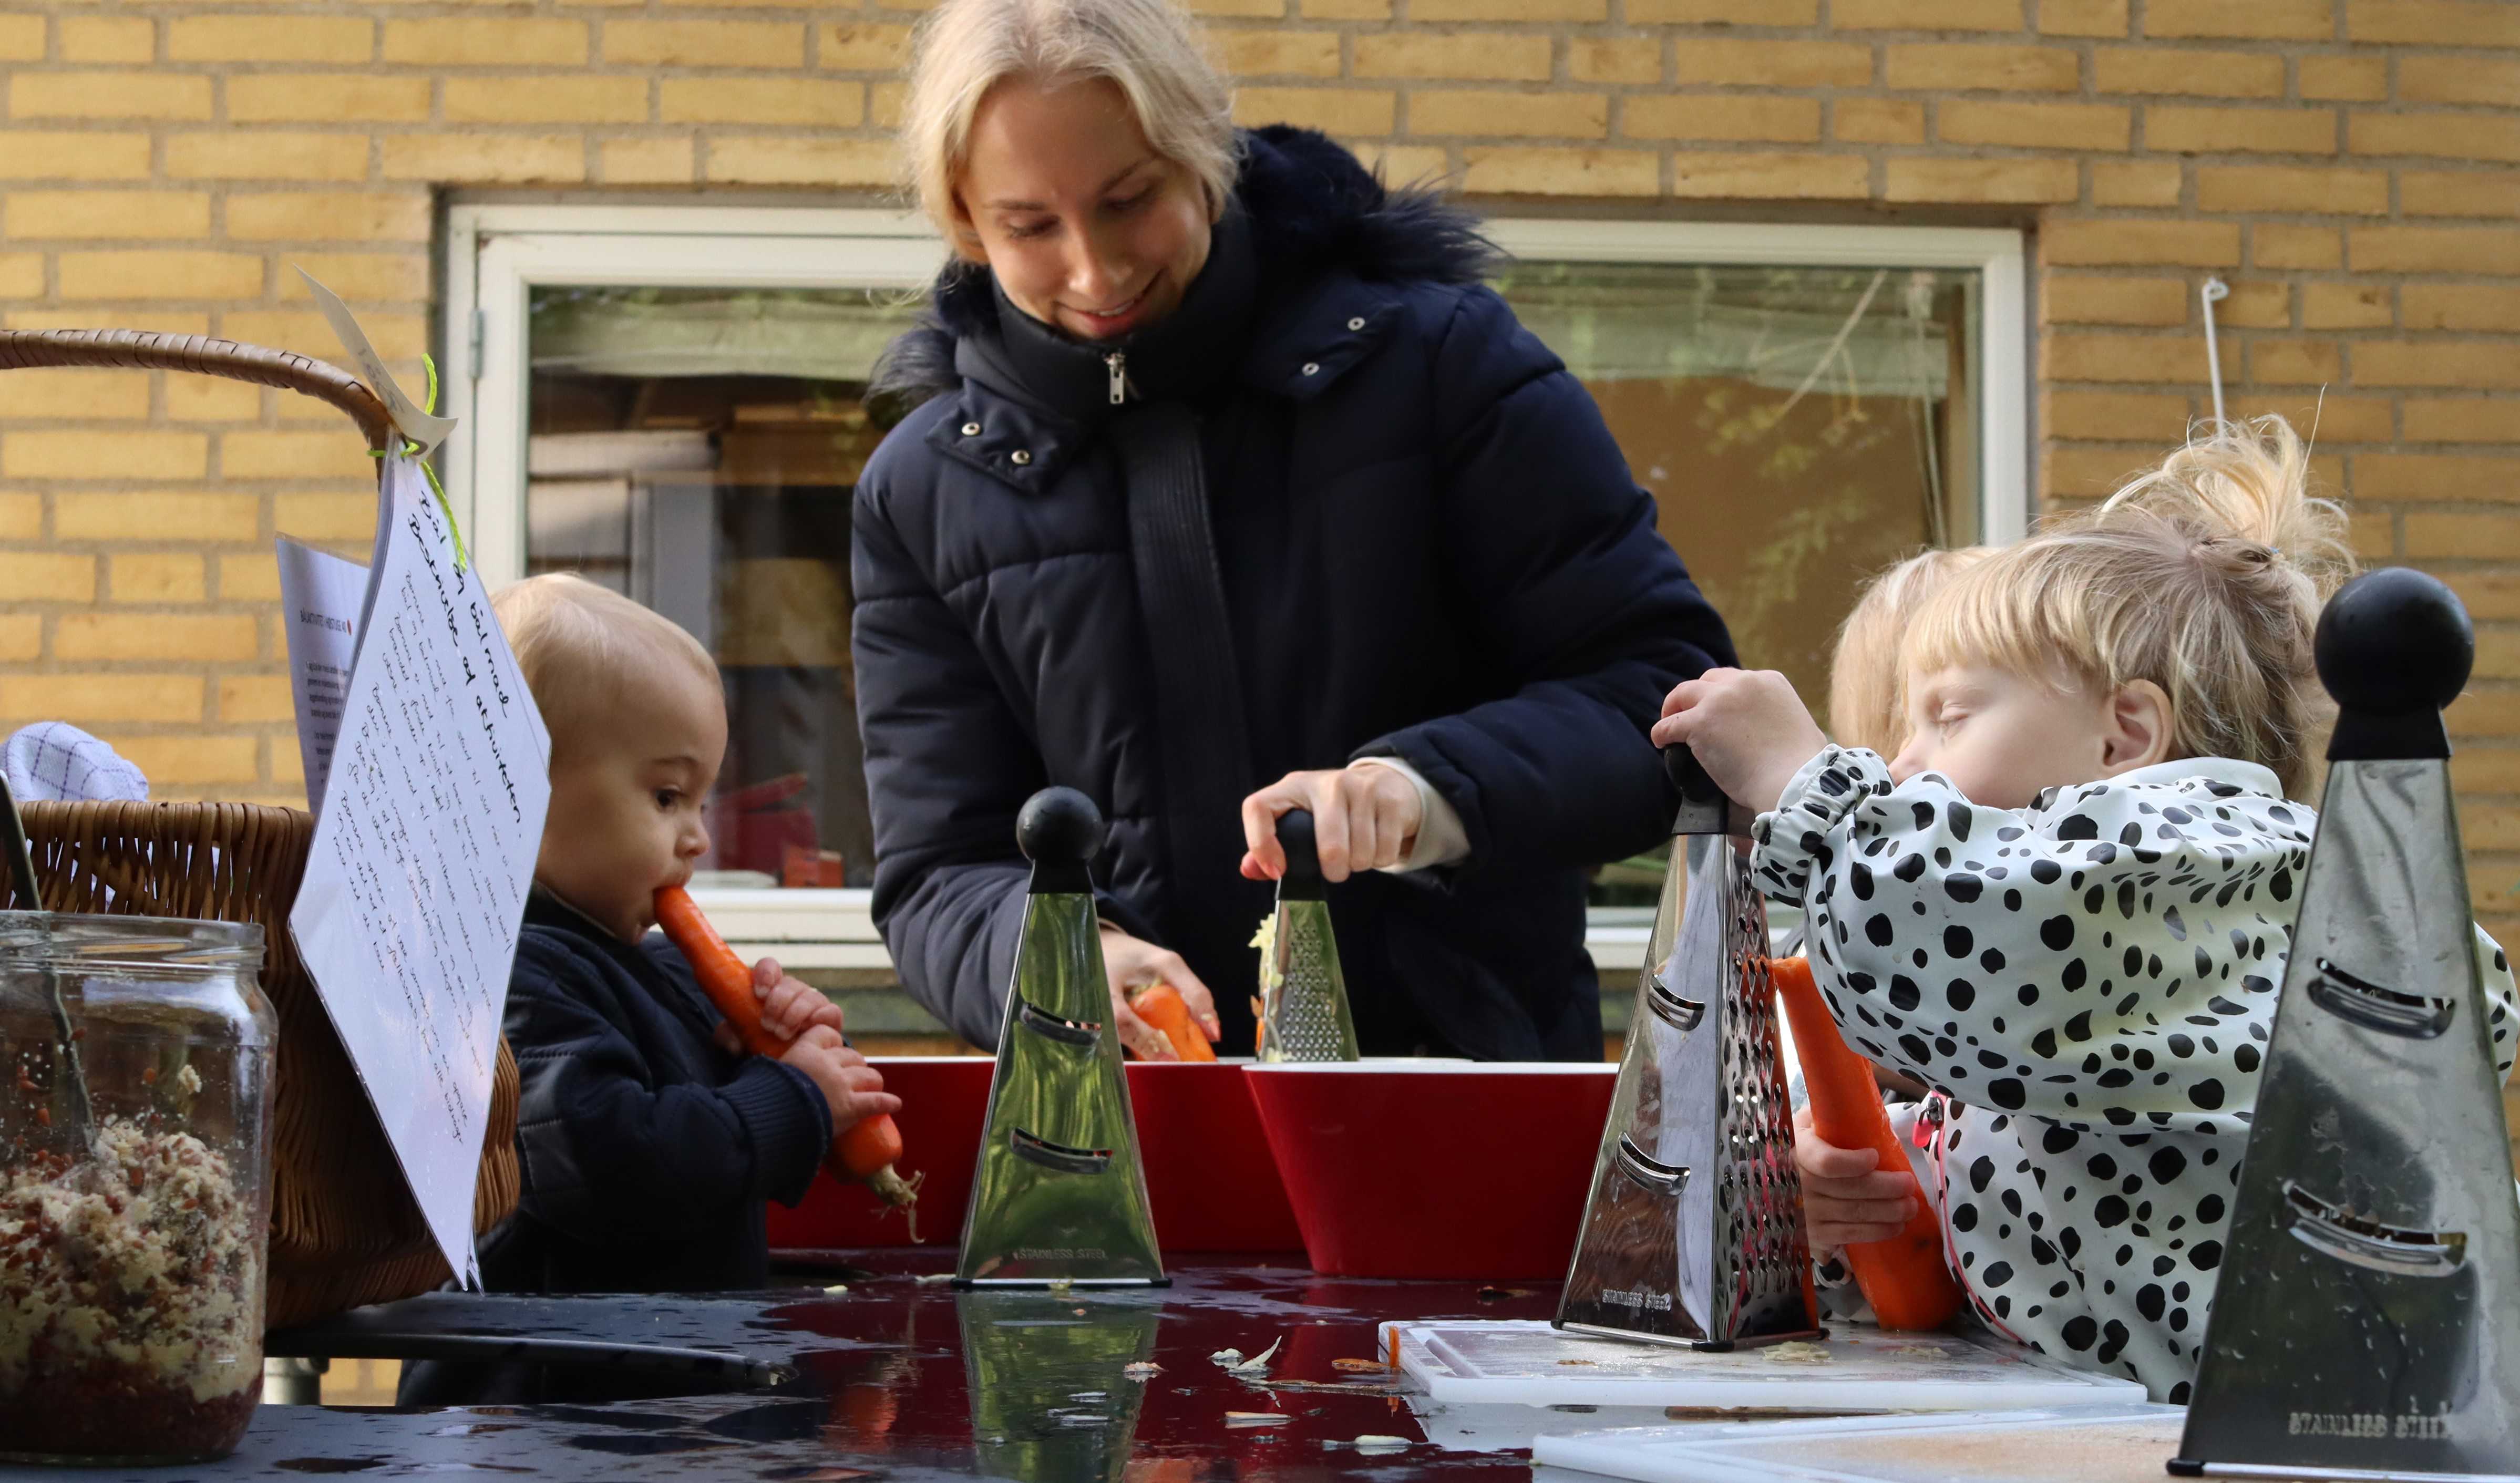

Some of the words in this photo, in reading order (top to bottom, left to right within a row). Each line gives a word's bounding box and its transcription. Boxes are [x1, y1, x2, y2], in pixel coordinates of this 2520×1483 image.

[407, 512, 459, 648] Beskrivelse
[462, 655, 477, 687] af
[419, 490, 447, 544] Bål
[453, 562, 465, 595] og
[469, 601, 509, 719] bålmad
[1020, 1248, 1074, 1260] STAINLESS
[1602, 1289, 1643, 1308] STAINLESS
[2288, 1412, 2388, 1438] STAINLESS
